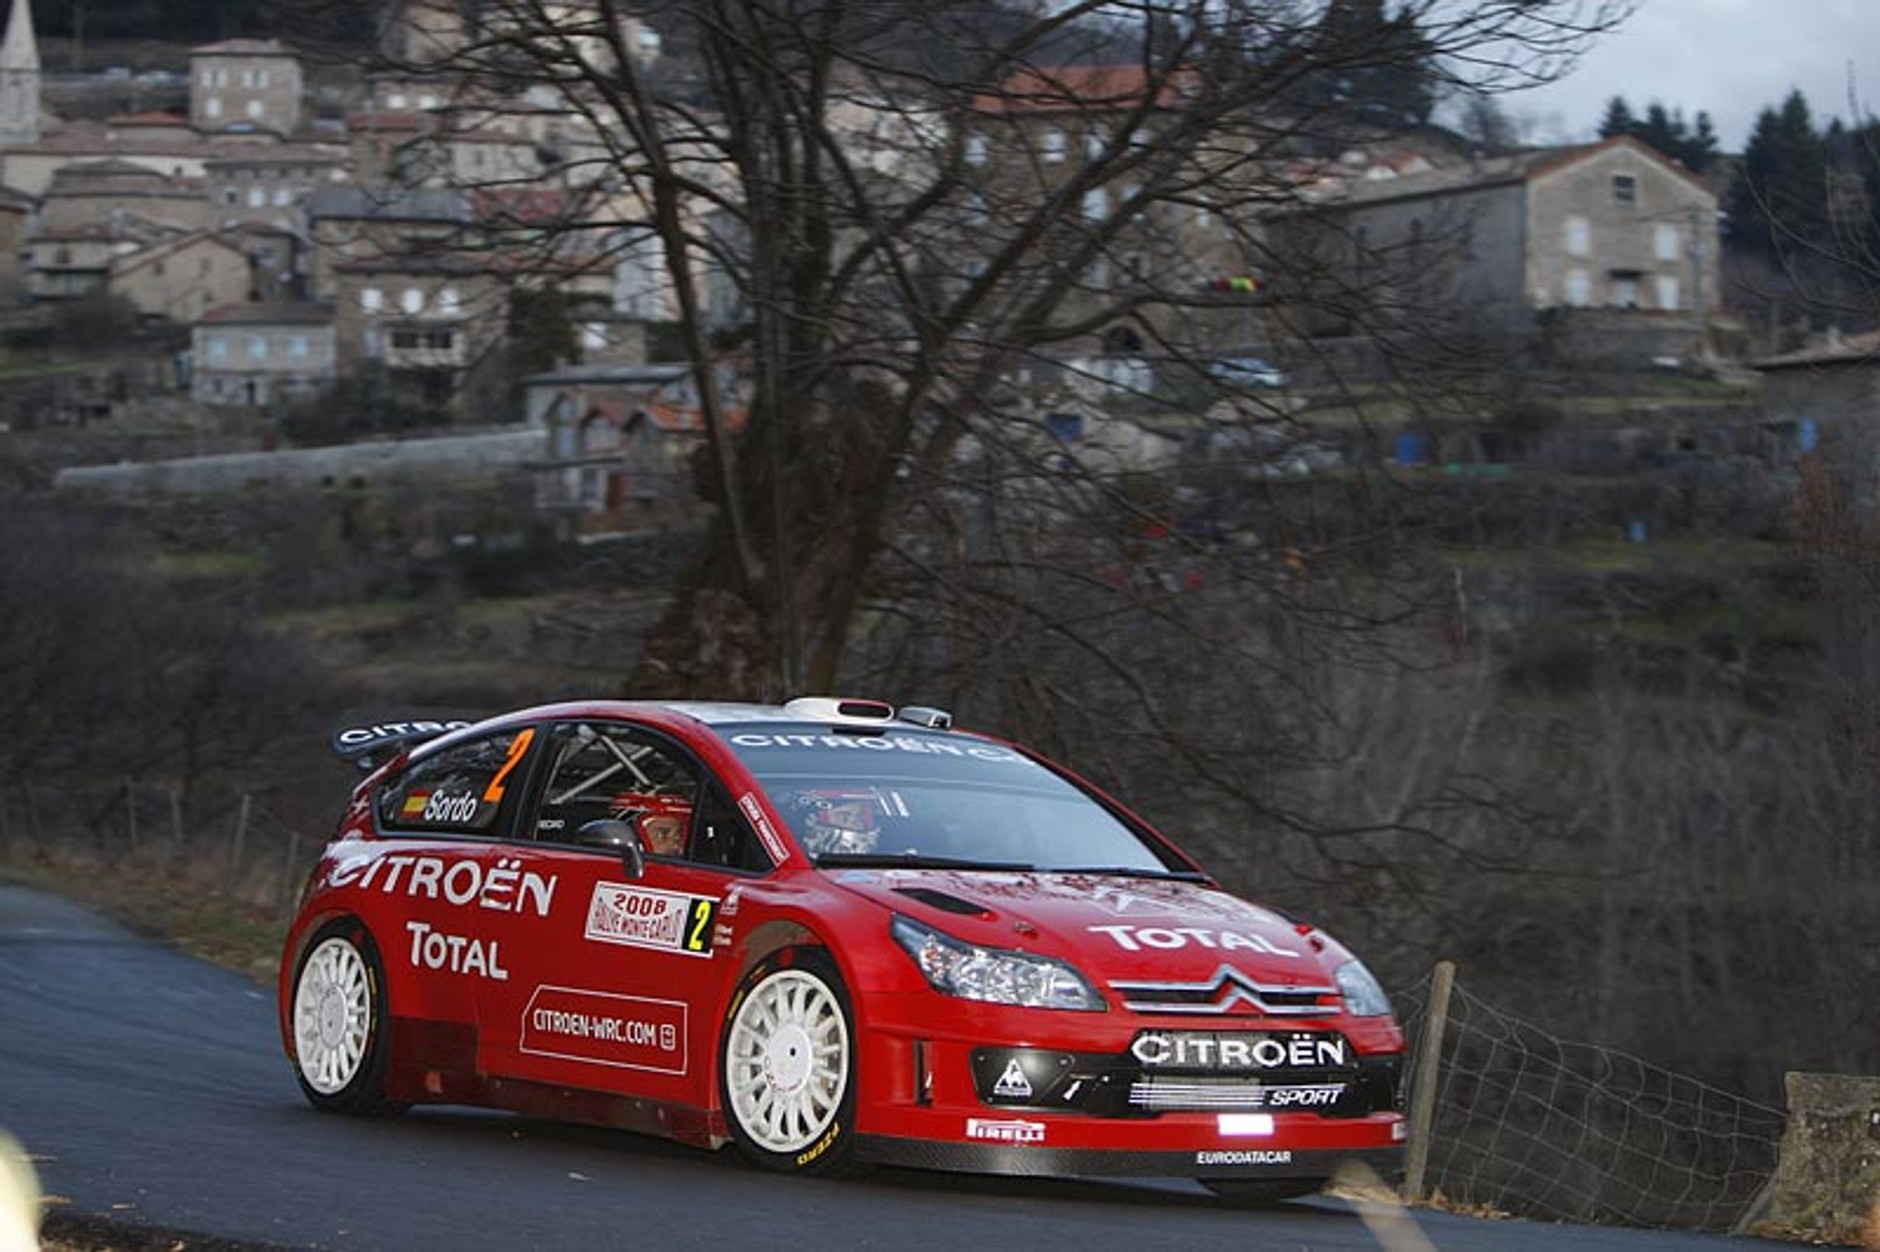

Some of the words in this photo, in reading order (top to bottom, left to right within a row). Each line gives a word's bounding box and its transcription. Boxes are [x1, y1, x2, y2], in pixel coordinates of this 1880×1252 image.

[731, 734, 963, 757] CITROËN
[483, 728, 535, 803] 2
[424, 789, 477, 822] Sordo
[329, 856, 557, 916] CITROËN
[613, 893, 667, 917] 2008
[688, 900, 711, 950] 2
[533, 1008, 657, 1046] CITROEN-WRC.COM
[1131, 1034, 1345, 1067] CITROËN
[1269, 1089, 1341, 1106] SPORT
[966, 1118, 1046, 1141] PIRELLI
[1196, 1151, 1292, 1165] EURODATACAR
